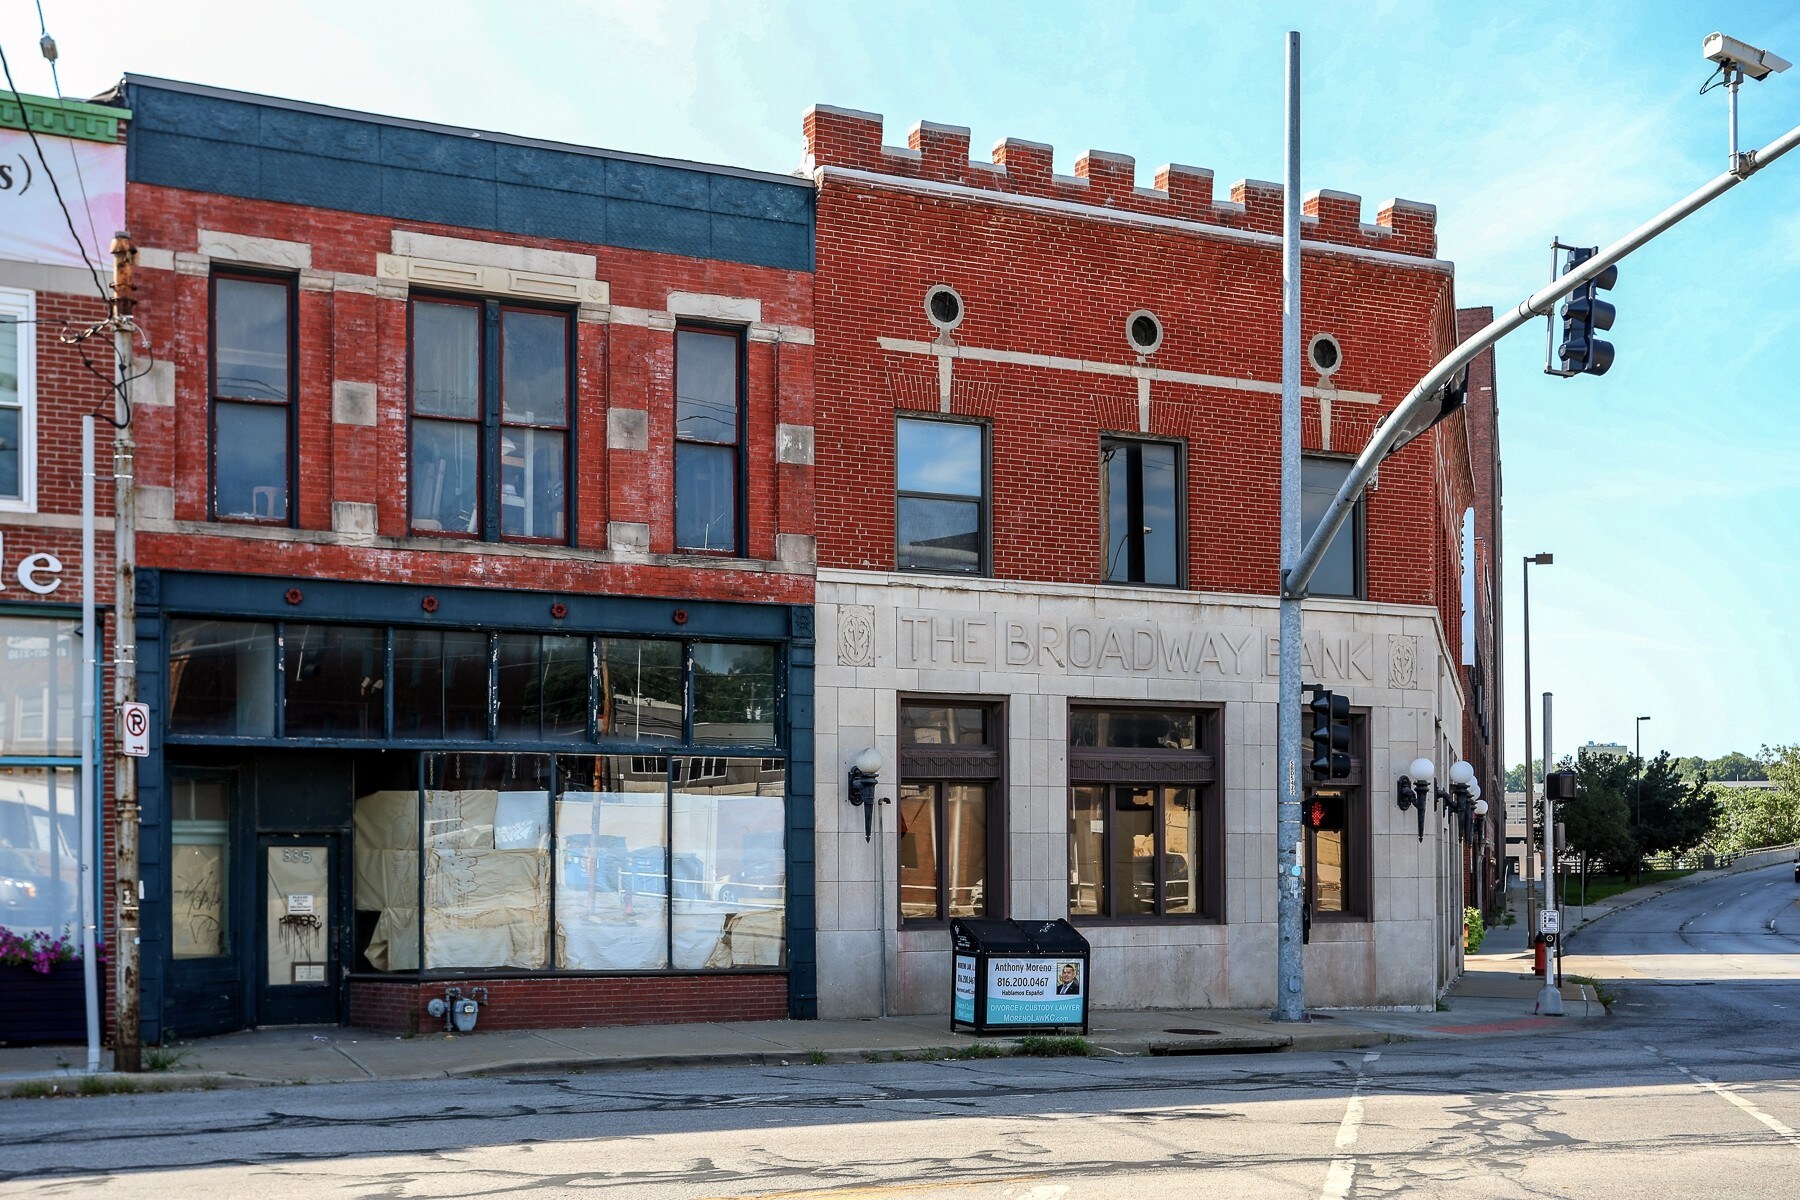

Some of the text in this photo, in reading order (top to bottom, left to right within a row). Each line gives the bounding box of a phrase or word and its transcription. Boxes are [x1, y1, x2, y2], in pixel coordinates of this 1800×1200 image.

[901, 615, 987, 664] THE
[1006, 619, 1253, 676] BROADWAY
[282, 848, 312, 864] 335
[995, 963, 1052, 973] Anthony Moreno
[997, 977, 1049, 987] 816.200.0467
[1025, 989, 1044, 997] Español
